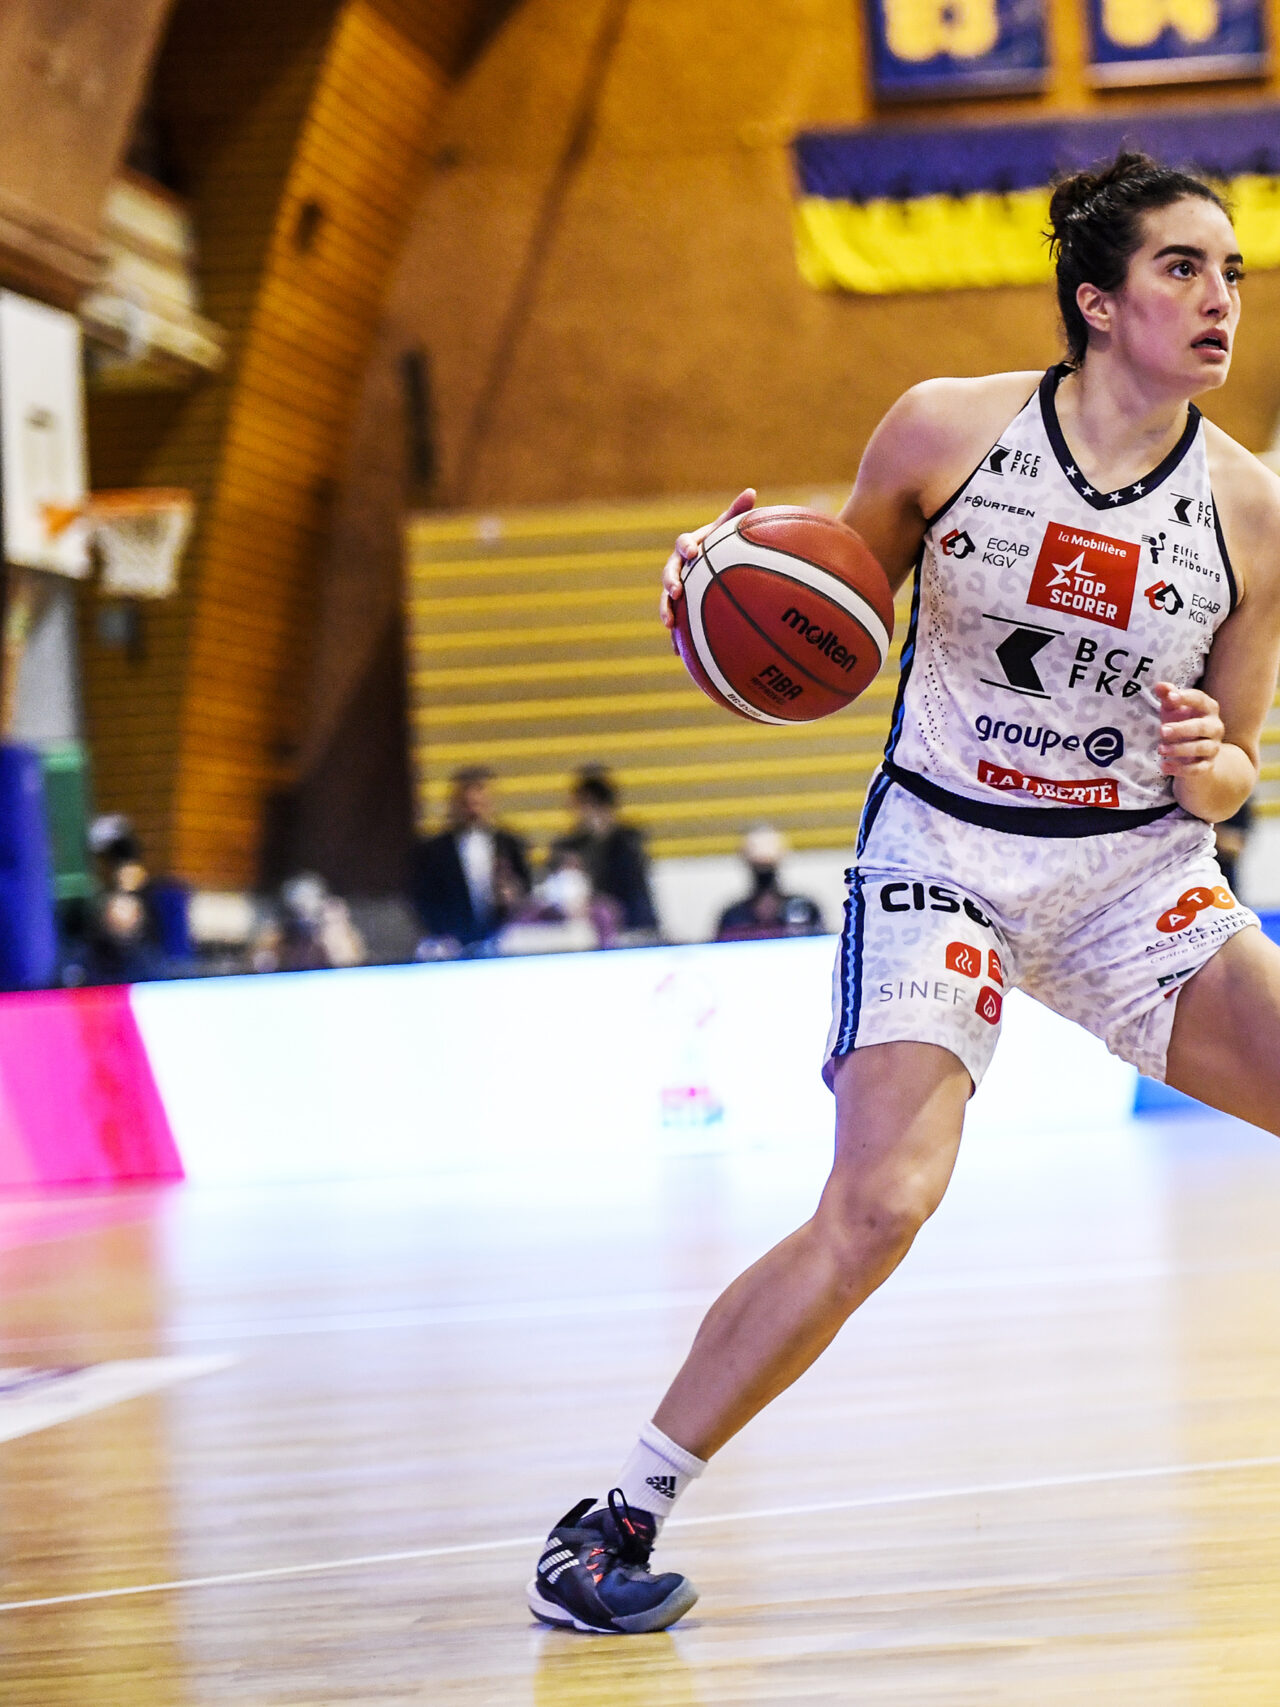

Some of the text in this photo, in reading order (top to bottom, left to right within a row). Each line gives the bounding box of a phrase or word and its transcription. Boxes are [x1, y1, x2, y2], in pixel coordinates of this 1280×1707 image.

[1010, 461, 1038, 478] FKB
[1015, 450, 1041, 466] BCF
[964, 495, 1035, 518] FOURTEEN
[1198, 501, 1212, 516] BC
[1196, 513, 1213, 529] FK
[986, 537, 1030, 557] ECAB
[1058, 531, 1127, 558] la Mobilière
[1173, 544, 1199, 560] Elfic
[982, 552, 1017, 569] KGV
[1172, 555, 1221, 582] Fribourg
[1073, 576, 1106, 597] TOP
[1050, 588, 1118, 620] SCORER
[1191, 593, 1221, 614] ECAB
[781, 607, 857, 673] molten
[1075, 637, 1154, 679] BCF
[758, 664, 803, 700] FIBA
[1068, 663, 1142, 698] FKB
[975, 714, 1080, 756] groupe
[986, 769, 1113, 804] LA LIBERTÉ
[1145, 926, 1206, 953] ACTIVE
[1188, 918, 1249, 944] CENTER
[879, 980, 966, 1005] SINEF
